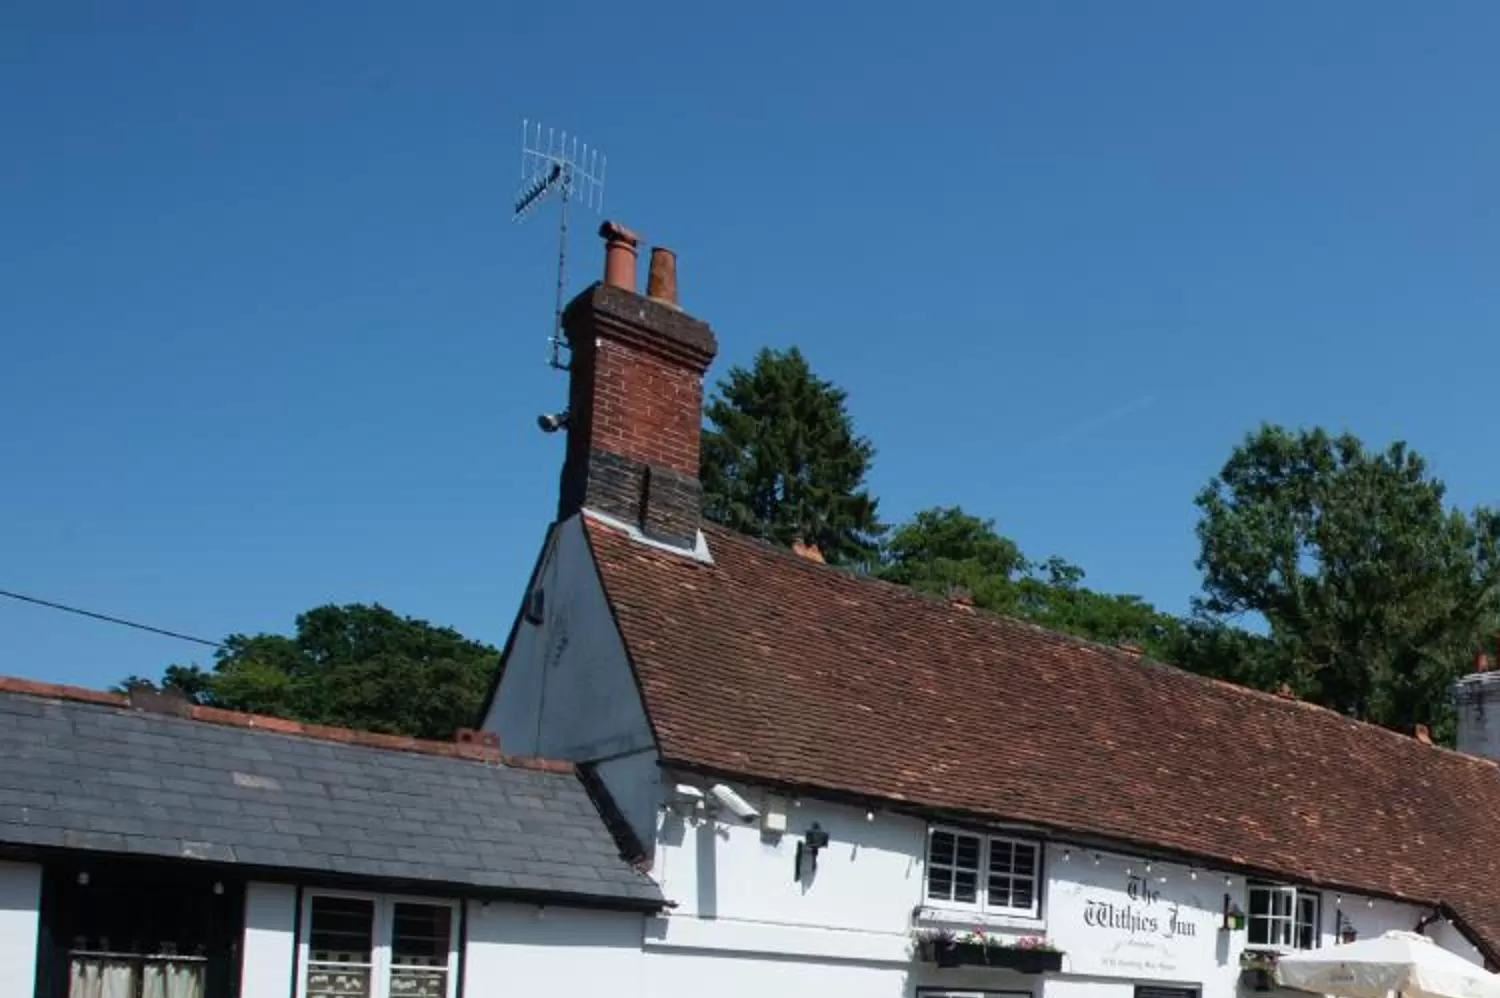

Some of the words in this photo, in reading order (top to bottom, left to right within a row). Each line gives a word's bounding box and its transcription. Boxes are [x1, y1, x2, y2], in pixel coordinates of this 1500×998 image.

[1127, 875, 1161, 906] The
[1083, 898, 1159, 934] Withies
[1163, 905, 1197, 938] Inn
